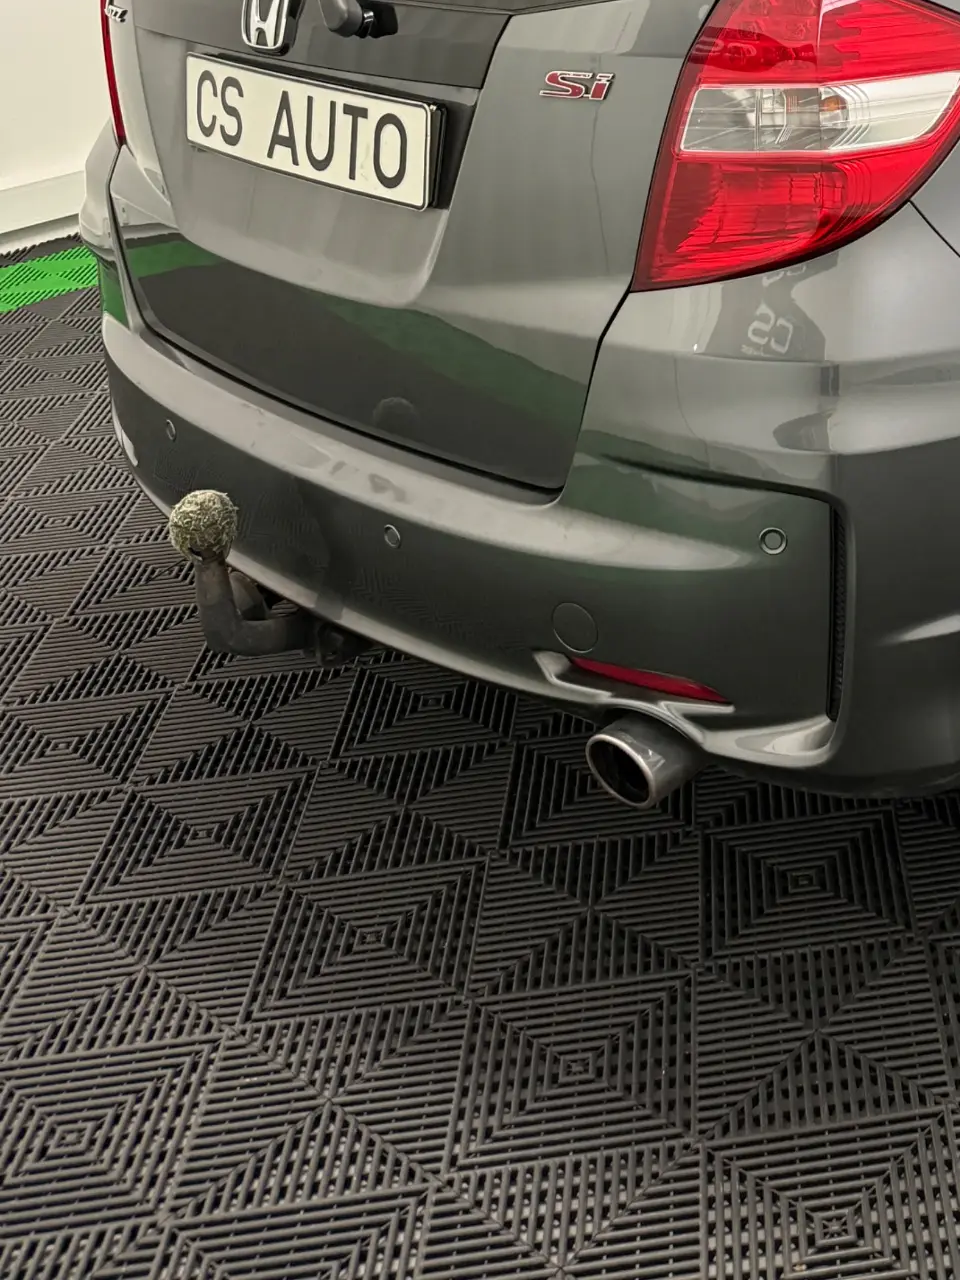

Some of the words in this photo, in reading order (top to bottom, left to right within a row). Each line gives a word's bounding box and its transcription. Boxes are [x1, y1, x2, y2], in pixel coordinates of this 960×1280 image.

[540, 70, 614, 101] Si
[196, 69, 244, 147] CS
[266, 90, 408, 189] AUTO
